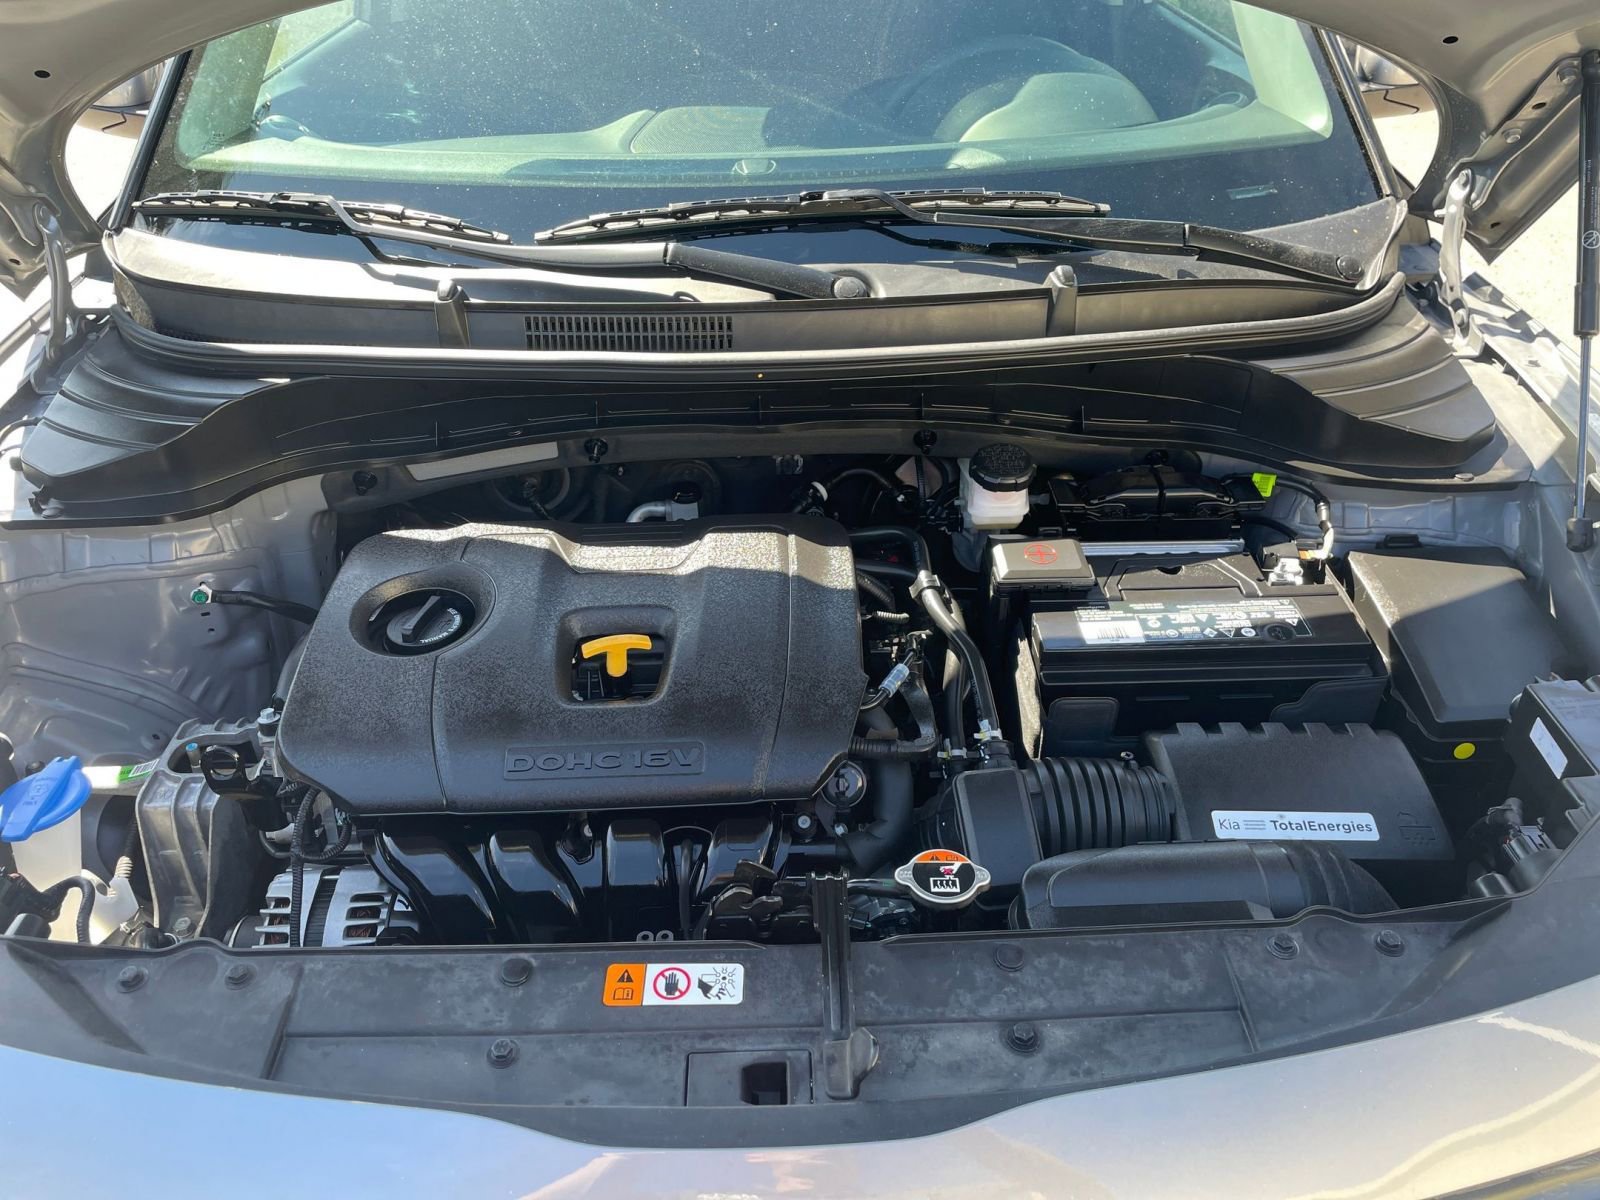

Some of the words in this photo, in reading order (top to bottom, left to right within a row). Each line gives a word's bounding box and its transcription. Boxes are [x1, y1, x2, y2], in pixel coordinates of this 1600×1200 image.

[506, 751, 622, 773] DOHC
[633, 748, 700, 769] 16V
[1218, 818, 1241, 831] Kia
[1269, 819, 1373, 834] TotalEnergies
